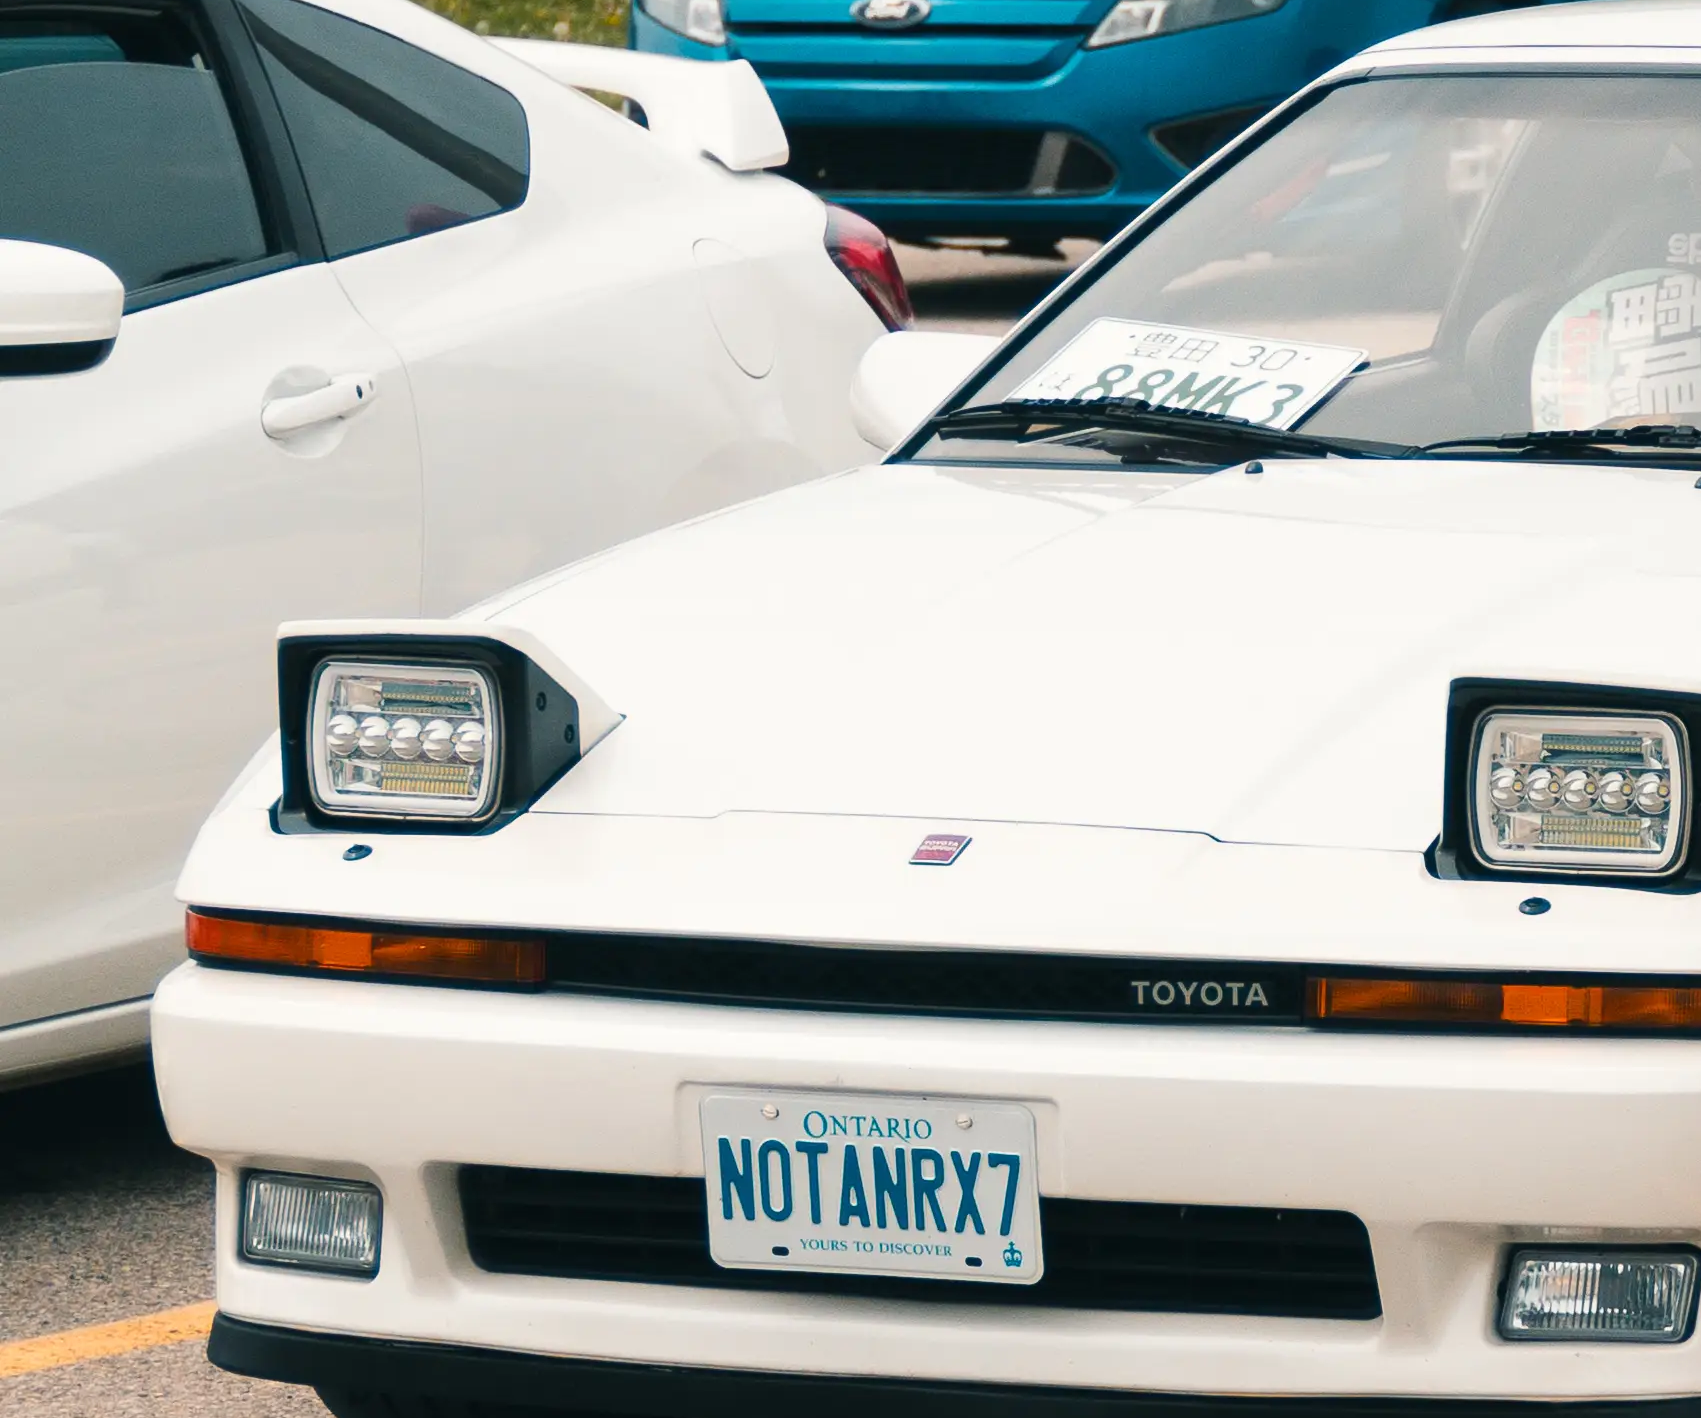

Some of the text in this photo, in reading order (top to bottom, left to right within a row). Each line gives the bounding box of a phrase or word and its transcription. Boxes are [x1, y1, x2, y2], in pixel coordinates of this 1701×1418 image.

[1231, 345, 1298, 371] 30
[1131, 981, 1269, 1006] TOYOTA
[717, 1137, 1021, 1236] NOTANRX7
[800, 1238, 953, 1257] YOURS TO DISCOVER
